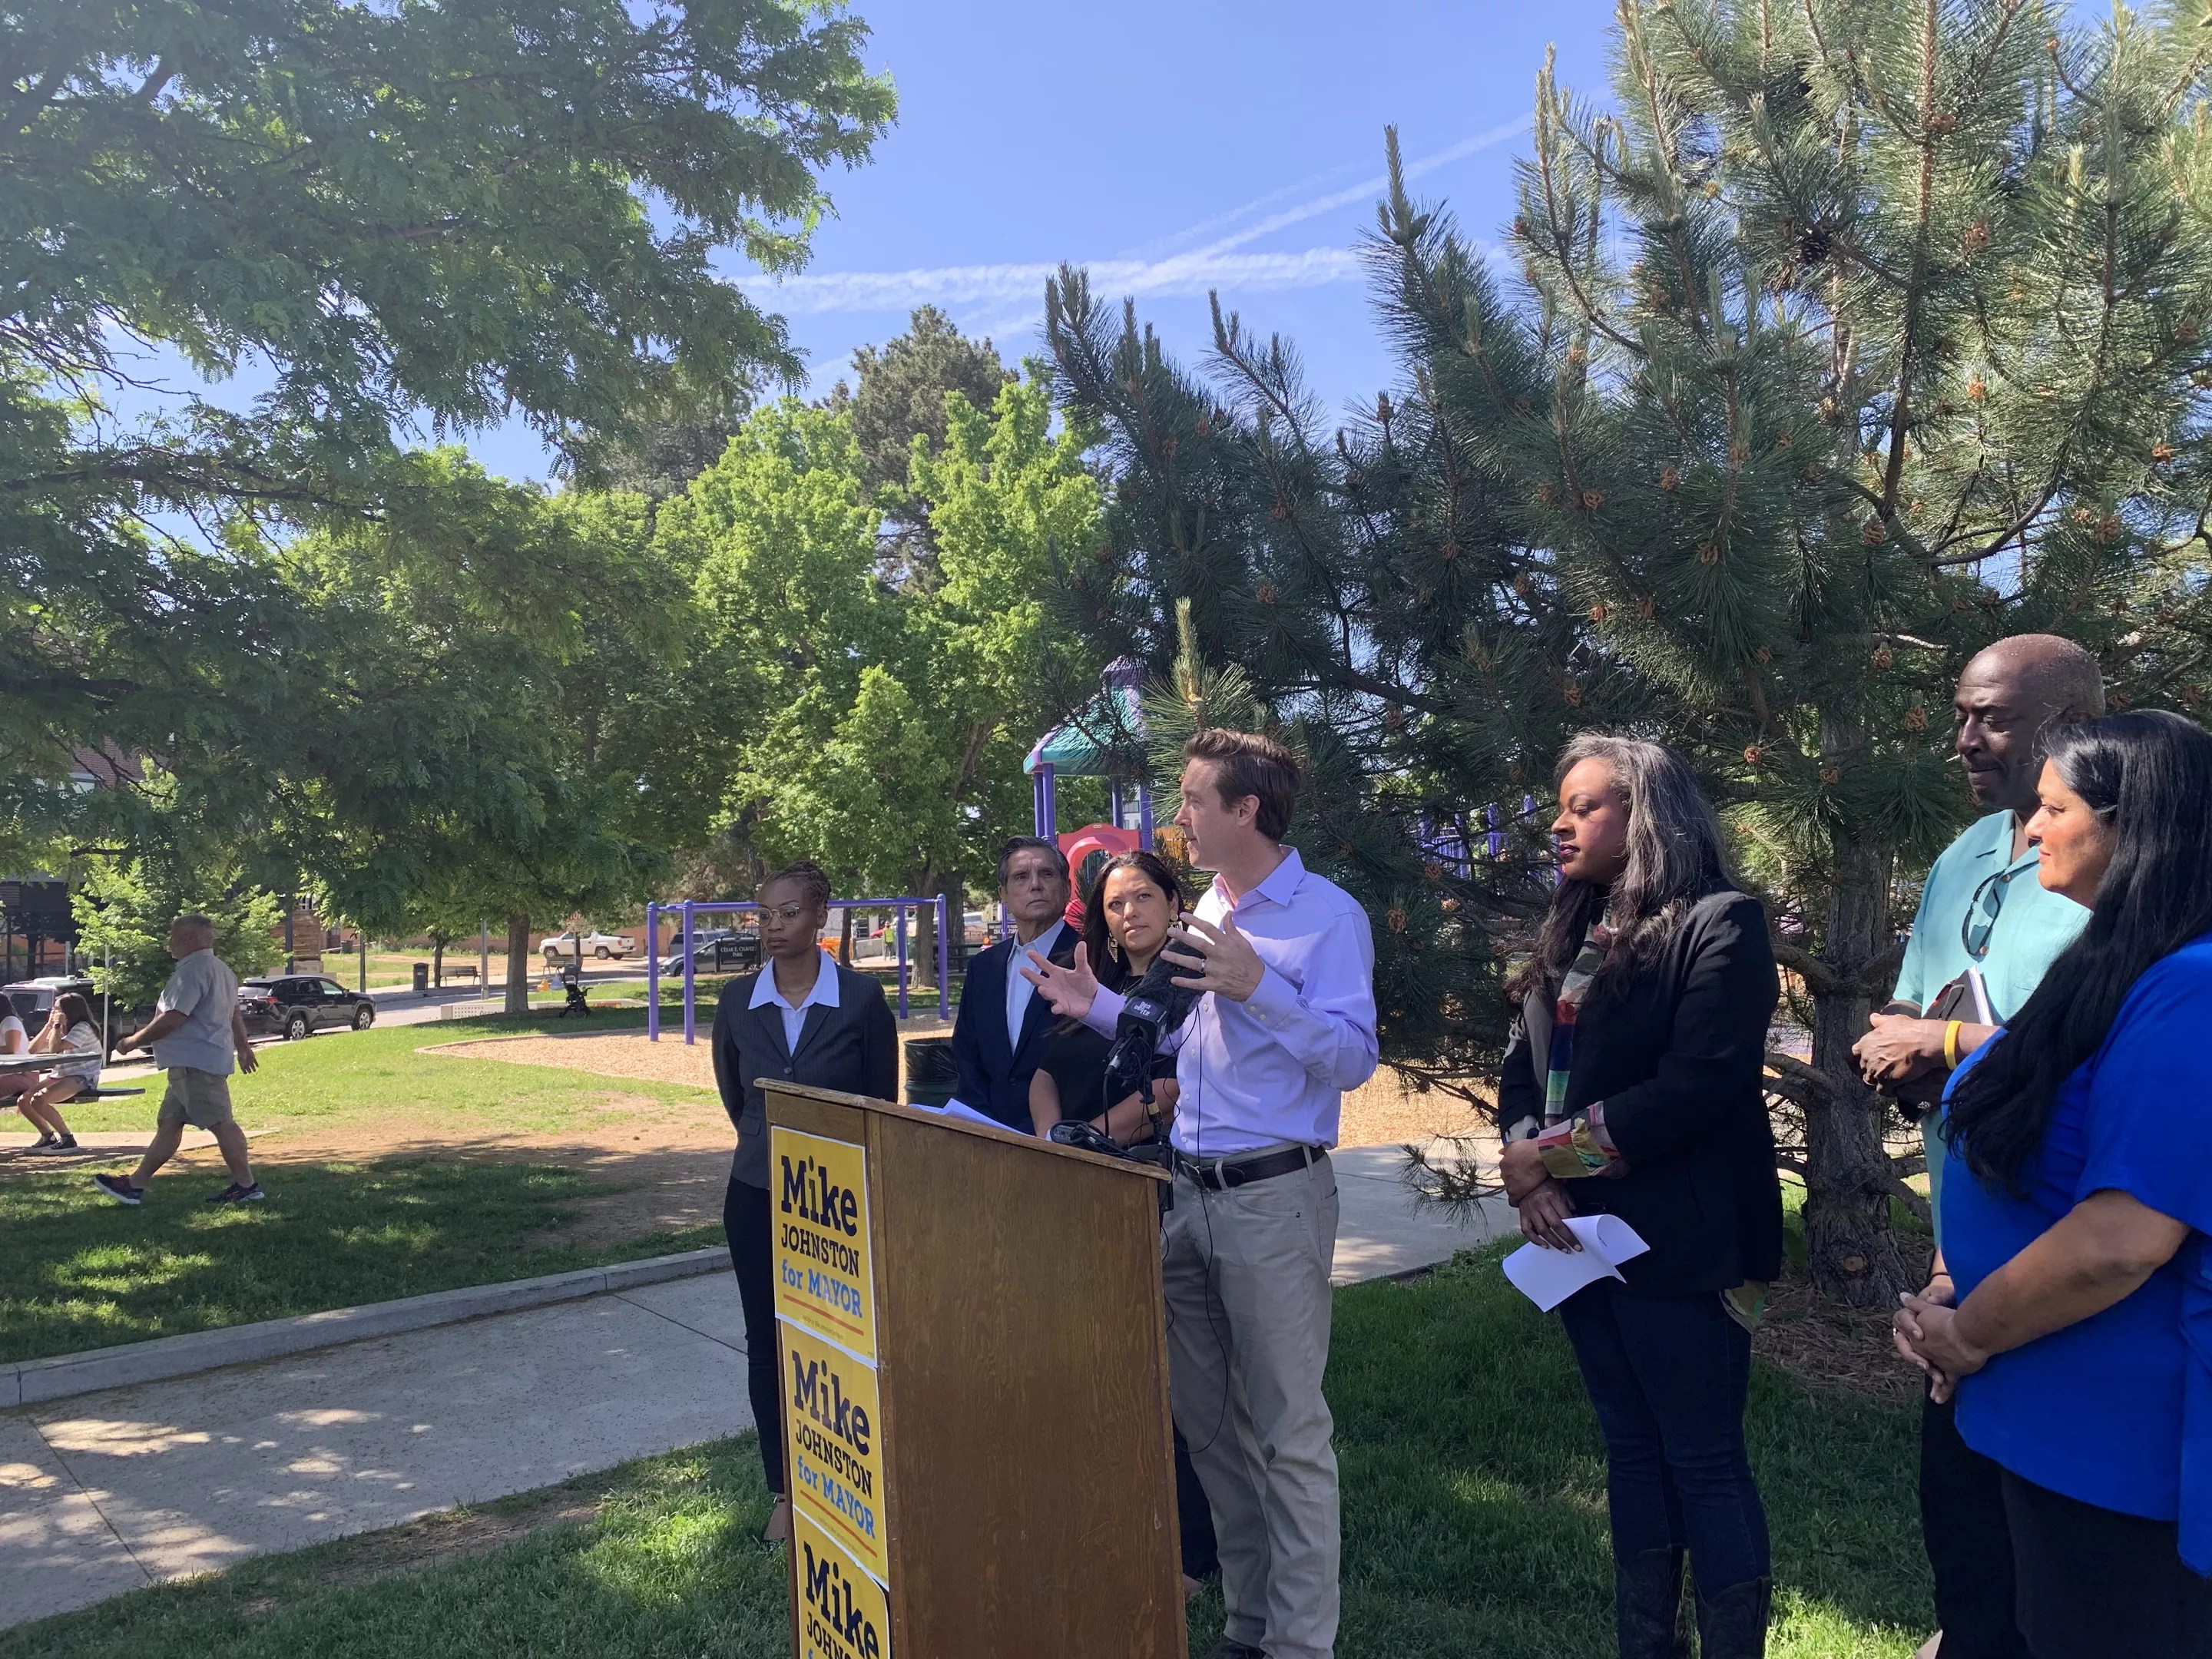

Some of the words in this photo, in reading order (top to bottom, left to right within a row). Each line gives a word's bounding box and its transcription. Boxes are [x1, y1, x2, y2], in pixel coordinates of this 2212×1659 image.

[780, 1154, 858, 1237] Mike
[781, 1223, 859, 1278] JOHNSTON
[782, 1258, 803, 1290] for
[808, 1268, 863, 1318] MAYOR
[792, 1349, 870, 1455] Mike
[796, 1419, 873, 1499] JOHNSTON
[797, 1455, 818, 1491] for
[821, 1472, 876, 1540] MAYOR
[803, 1541, 879, 1659] Mike
[806, 1610, 852, 1659] JOHN
